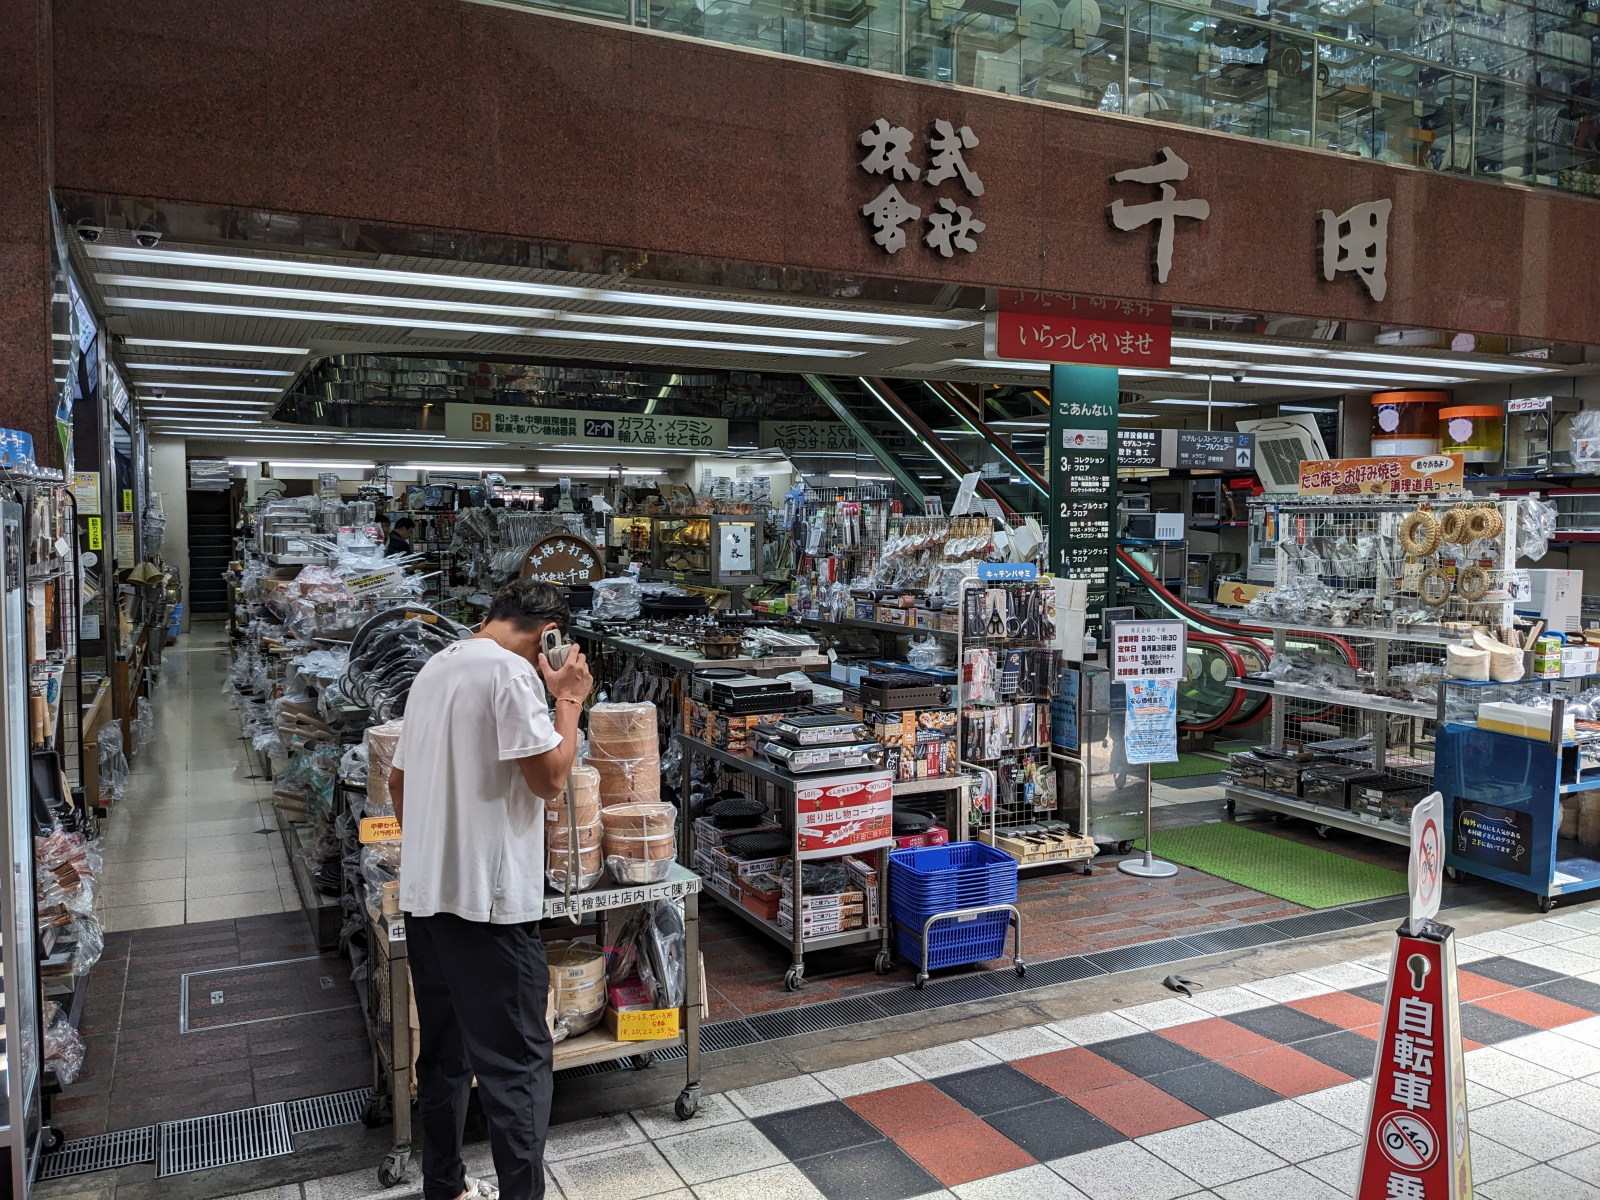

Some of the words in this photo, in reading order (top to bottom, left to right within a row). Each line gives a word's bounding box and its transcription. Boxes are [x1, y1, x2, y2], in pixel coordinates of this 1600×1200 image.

[1018, 323, 1154, 355] いらっしゃいませ
[1059, 402, 1113, 417] ごあんない
[1509, 401, 1545, 410] ポップコーン
[473, 414, 491, 432] B1
[585, 420, 603, 436] 2F
[618, 416, 713, 435] ガラス・メラミン
[617, 430, 713, 447] 輸入品・せともの
[1122, 440, 1156, 448] モデルコーナー
[1237, 434, 1249, 446] 2F
[1060, 456, 1072, 472] 3F
[1074, 456, 1105, 464] コレクション
[1074, 464, 1090, 472] フロア
[1416, 459, 1449, 470] 色々あるよ！
[1300, 470, 1342, 490] たこ焼き
[1344, 461, 1401, 484] お好み焼き
[1390, 477, 1462, 493] 調理道具コーナー
[1060, 502, 1071, 518] 2F
[1072, 502, 1108, 510] テーブルウェア
[1072, 510, 1088, 518] フロア
[1072, 548, 1109, 556] キッチングッズ
[985, 569, 1031, 579] キッチンバサミ
[1117, 635, 1140, 643] 営業時間
[1117, 645, 1137, 653] 定休日
[806, 805, 885, 825] 掘り出し物コーナー
[552, 880, 697, 915] 国産檜製は店内にて陳列
[810, 898, 838, 907] たこ焼プレート
[812, 912, 839, 920] たこ焼プレート
[392, 925, 405, 939] 中
[811, 925, 838, 933] たこ焼プレート
[620, 1013, 647, 1022] ステンレス
[1390, 995, 1434, 1111] 自転車
